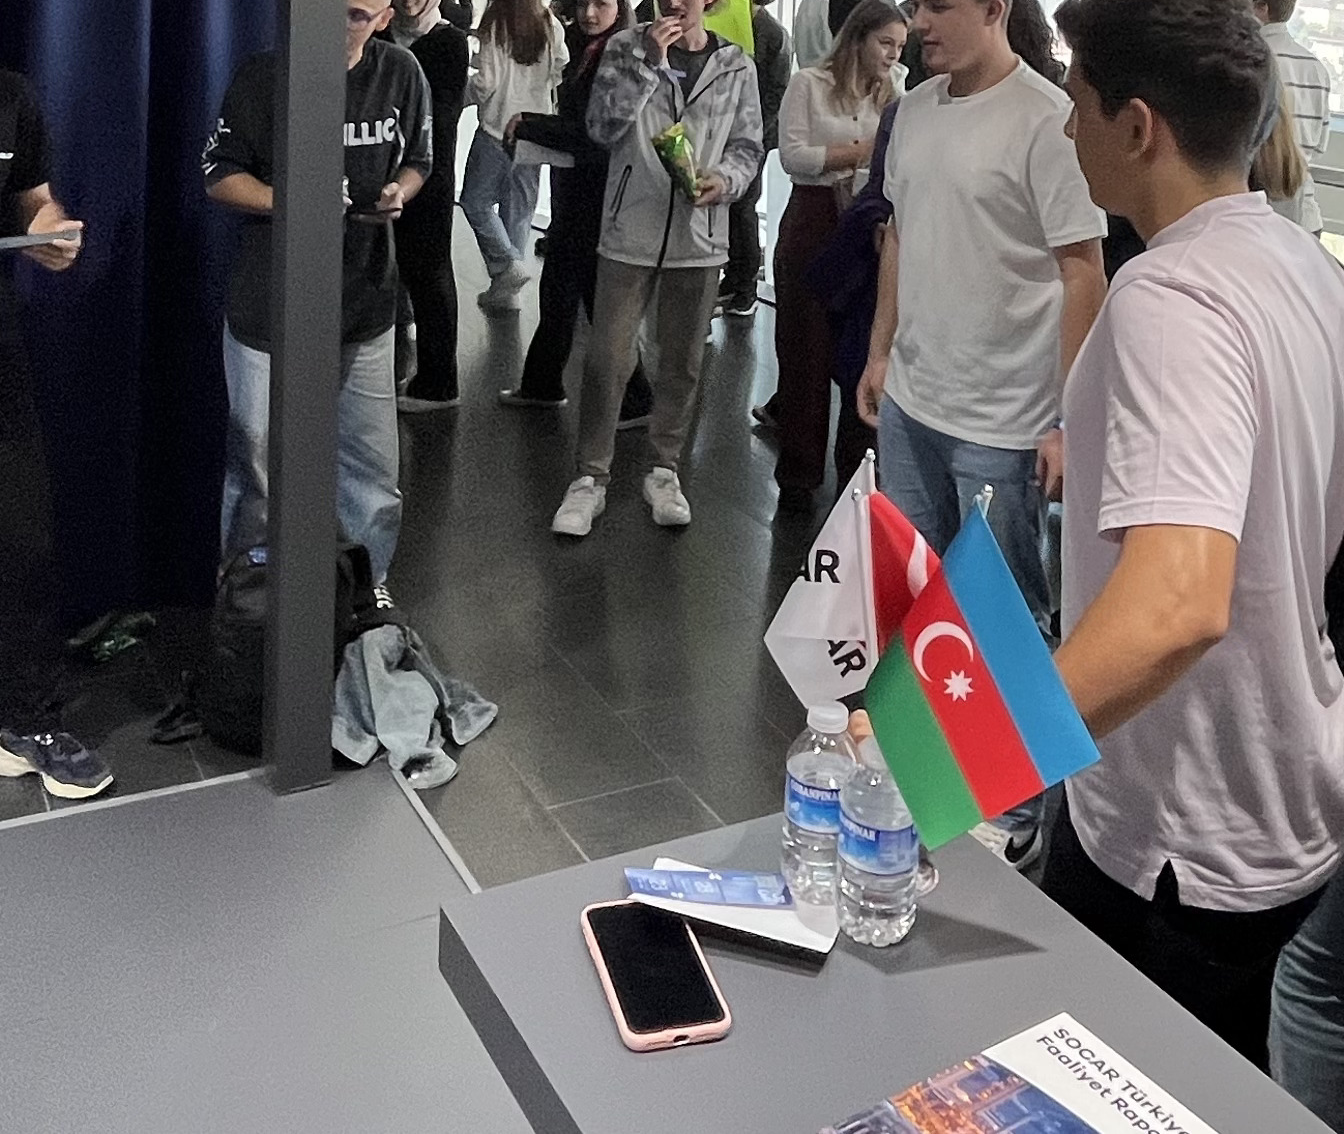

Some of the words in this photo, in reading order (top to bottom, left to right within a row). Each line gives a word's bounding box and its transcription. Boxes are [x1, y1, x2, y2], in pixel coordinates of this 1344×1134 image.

[1036, 1036, 1112, 1098] Faaliyet
[1110, 1097, 1161, 1134] Rap
[1053, 1028, 1120, 1082] SOCAR
[1121, 1079, 1190, 1134] Türkiy
